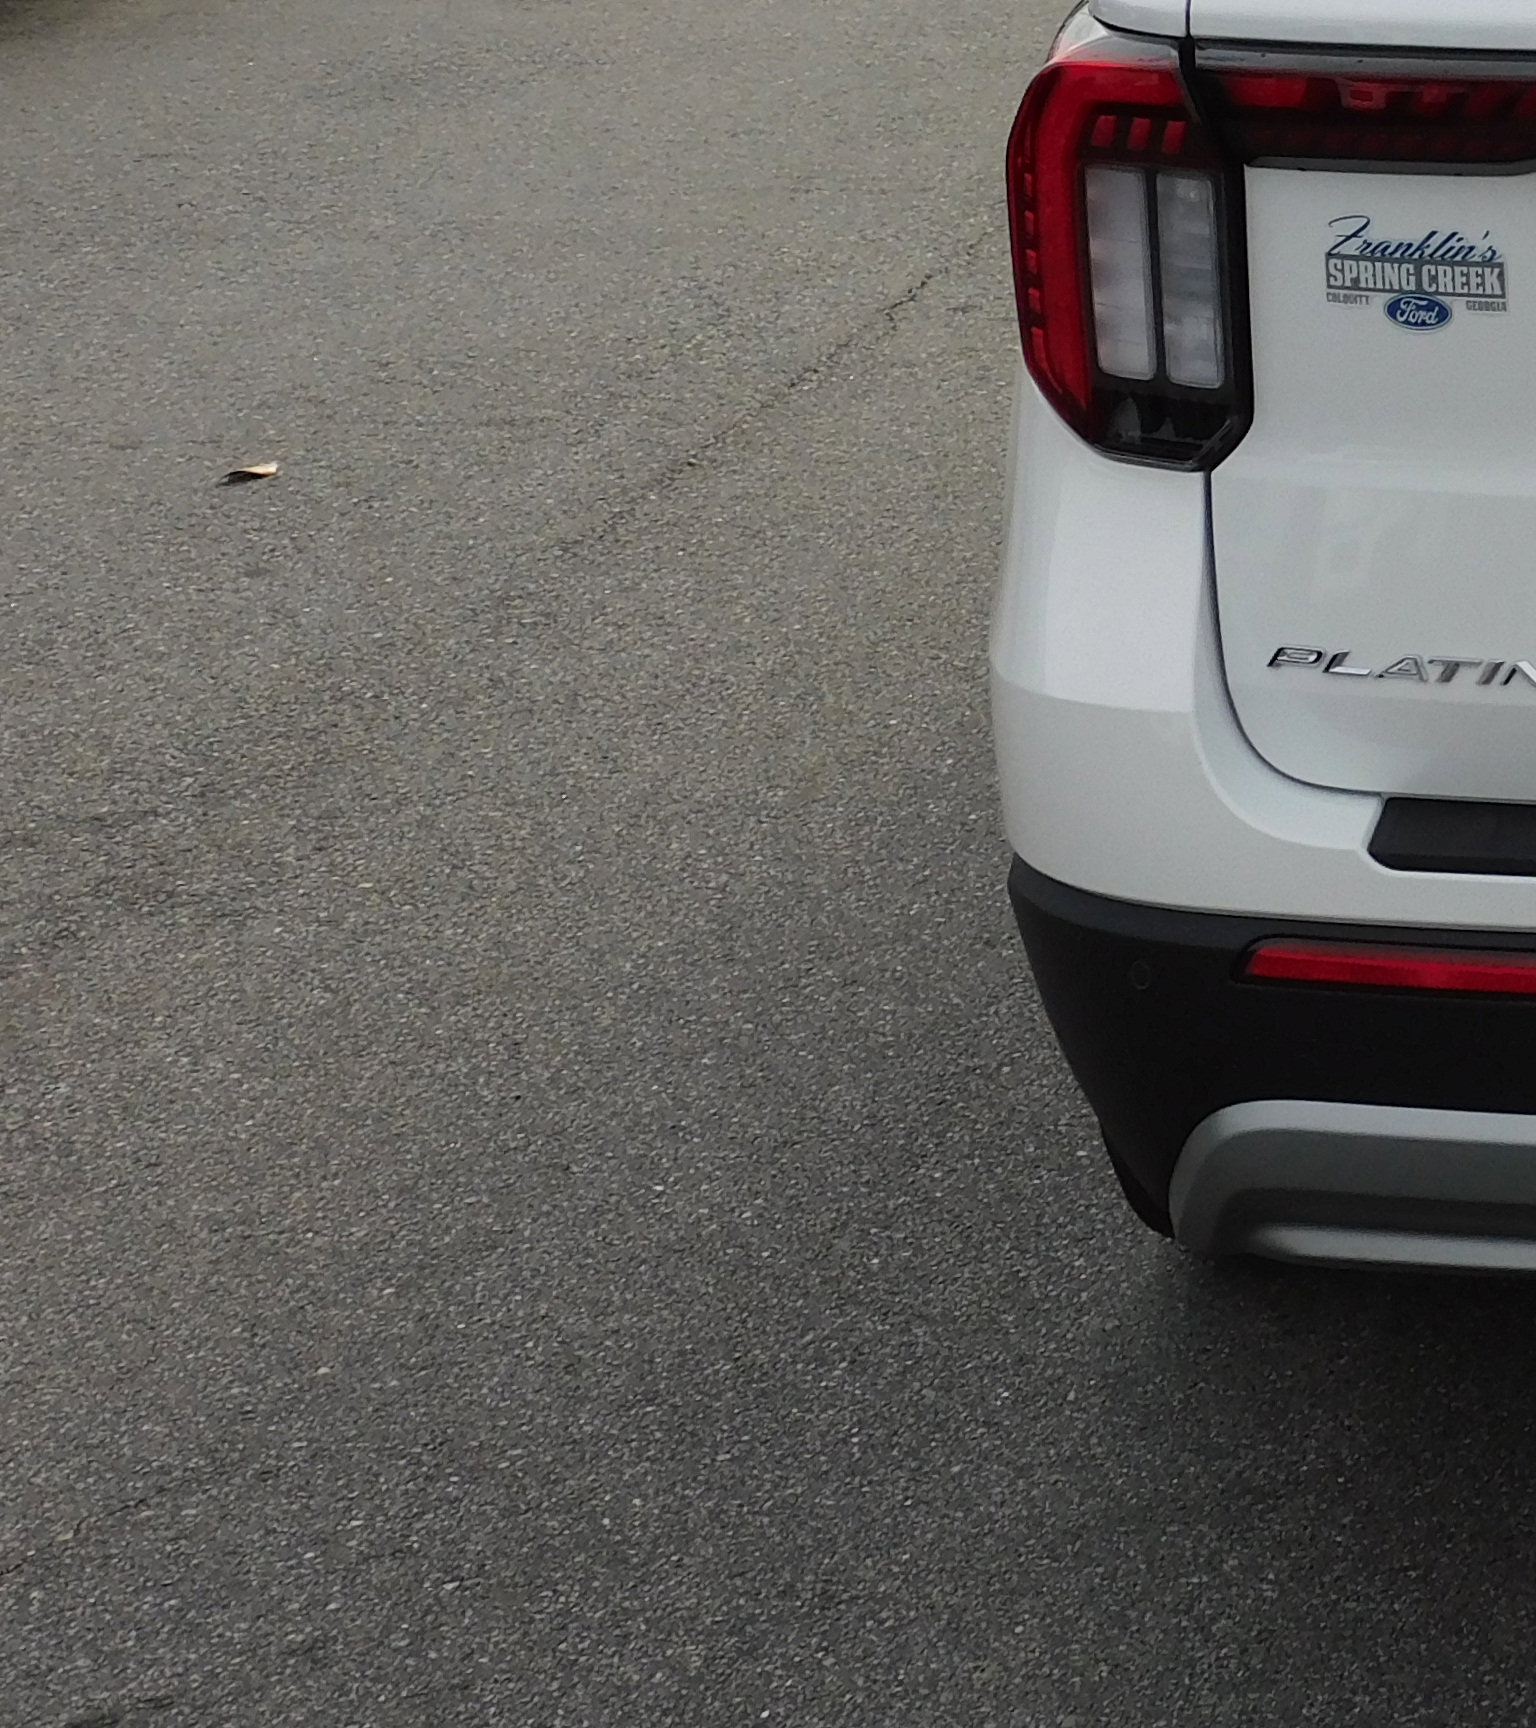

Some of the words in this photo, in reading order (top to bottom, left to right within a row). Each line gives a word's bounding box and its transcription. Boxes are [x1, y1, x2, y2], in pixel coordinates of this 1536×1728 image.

[1328, 214, 1502, 262] Franklin's
[1328, 258, 1416, 291] SPRING
[1421, 263, 1503, 295] CREEK
[1396, 297, 1440, 325] Ford
